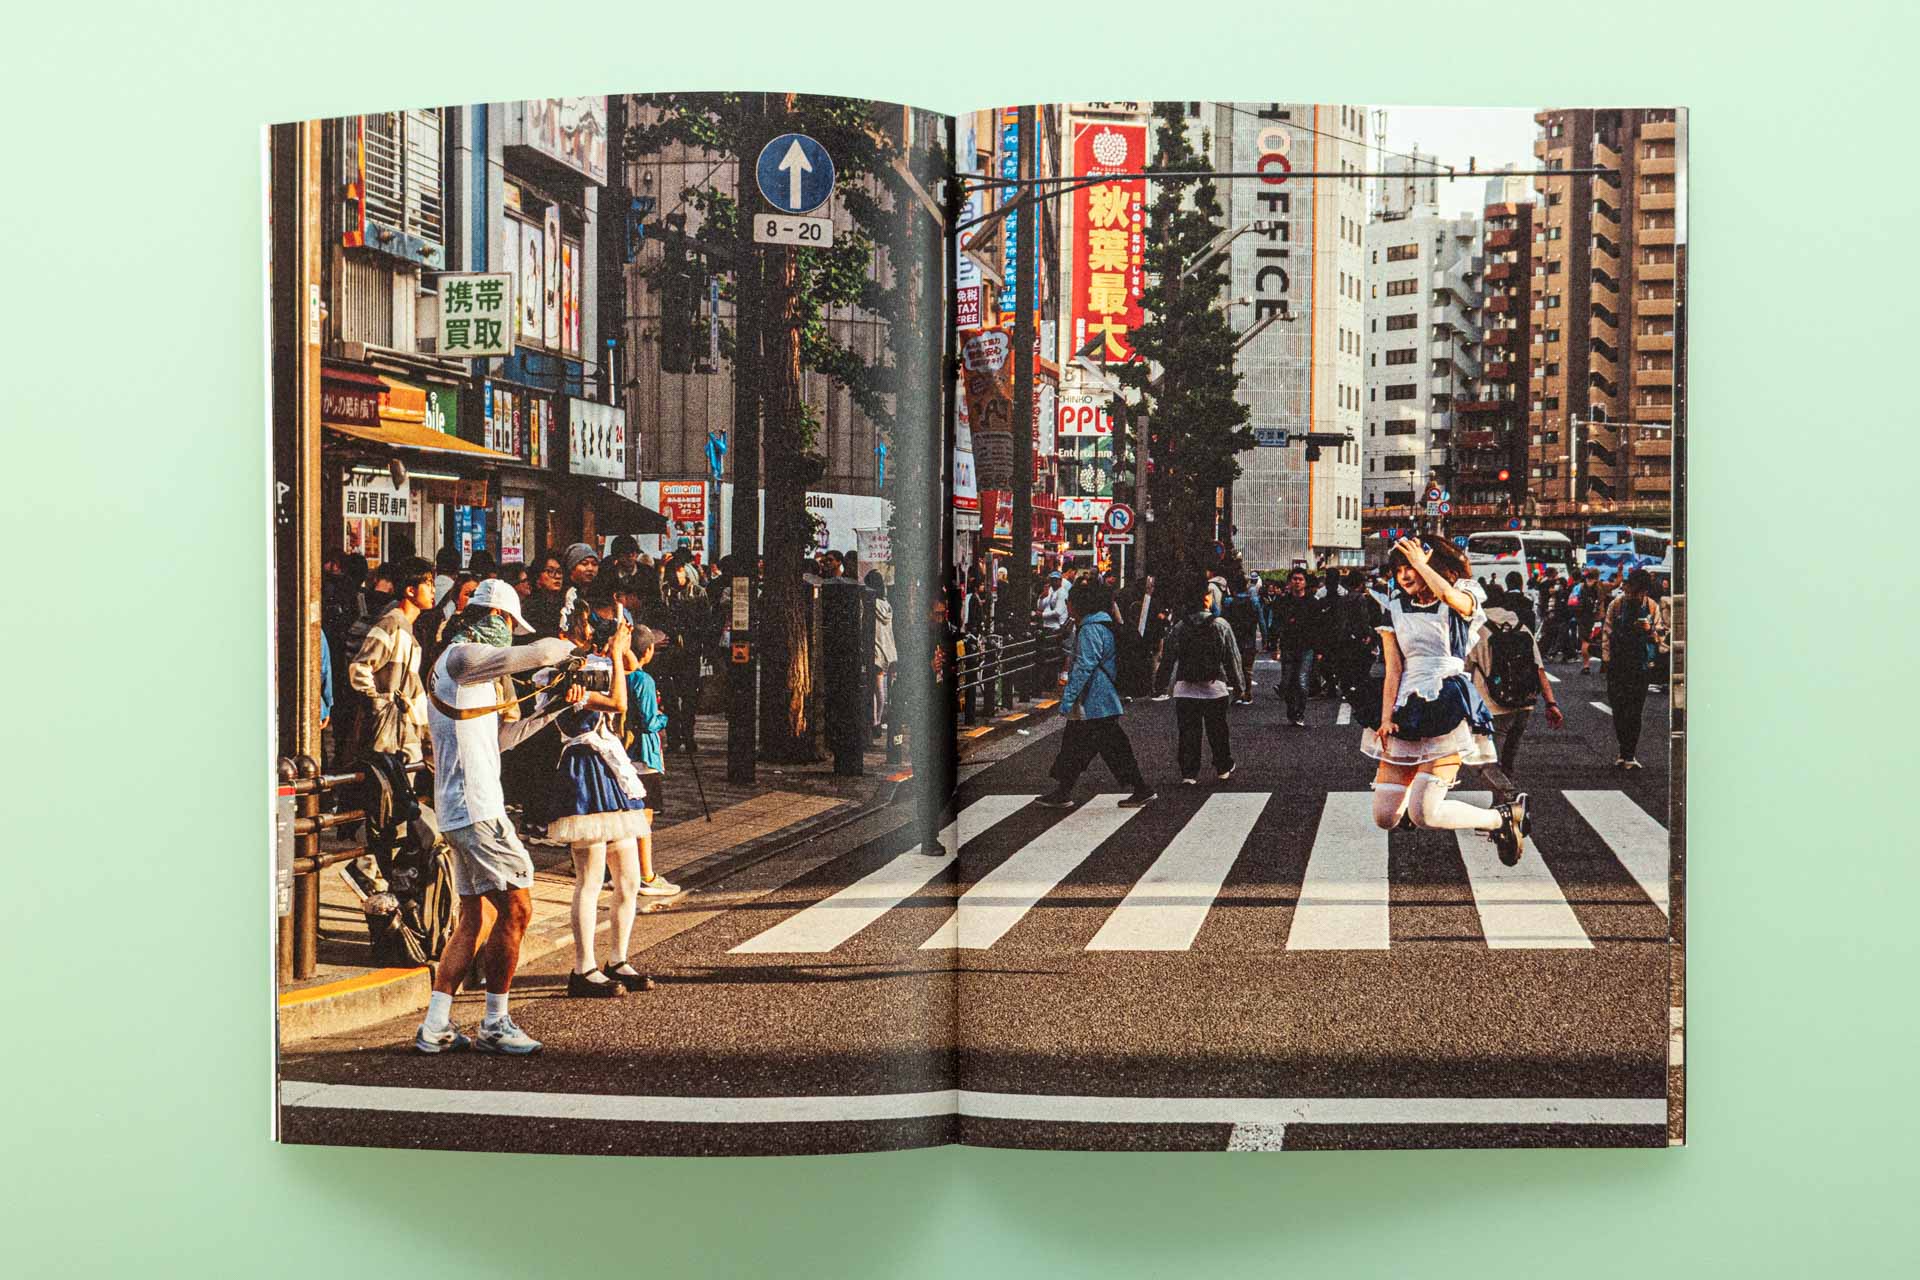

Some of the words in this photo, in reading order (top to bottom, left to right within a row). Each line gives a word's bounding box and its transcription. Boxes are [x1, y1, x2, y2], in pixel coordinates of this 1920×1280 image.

[1088, 184, 1130, 359] 秋葉最大
[444, 280, 504, 314] 携帯
[957, 287, 978, 303] 免税
[957, 302, 978, 315] TAX
[444, 318, 503, 350] 買取
[806, 495, 833, 509] ation
